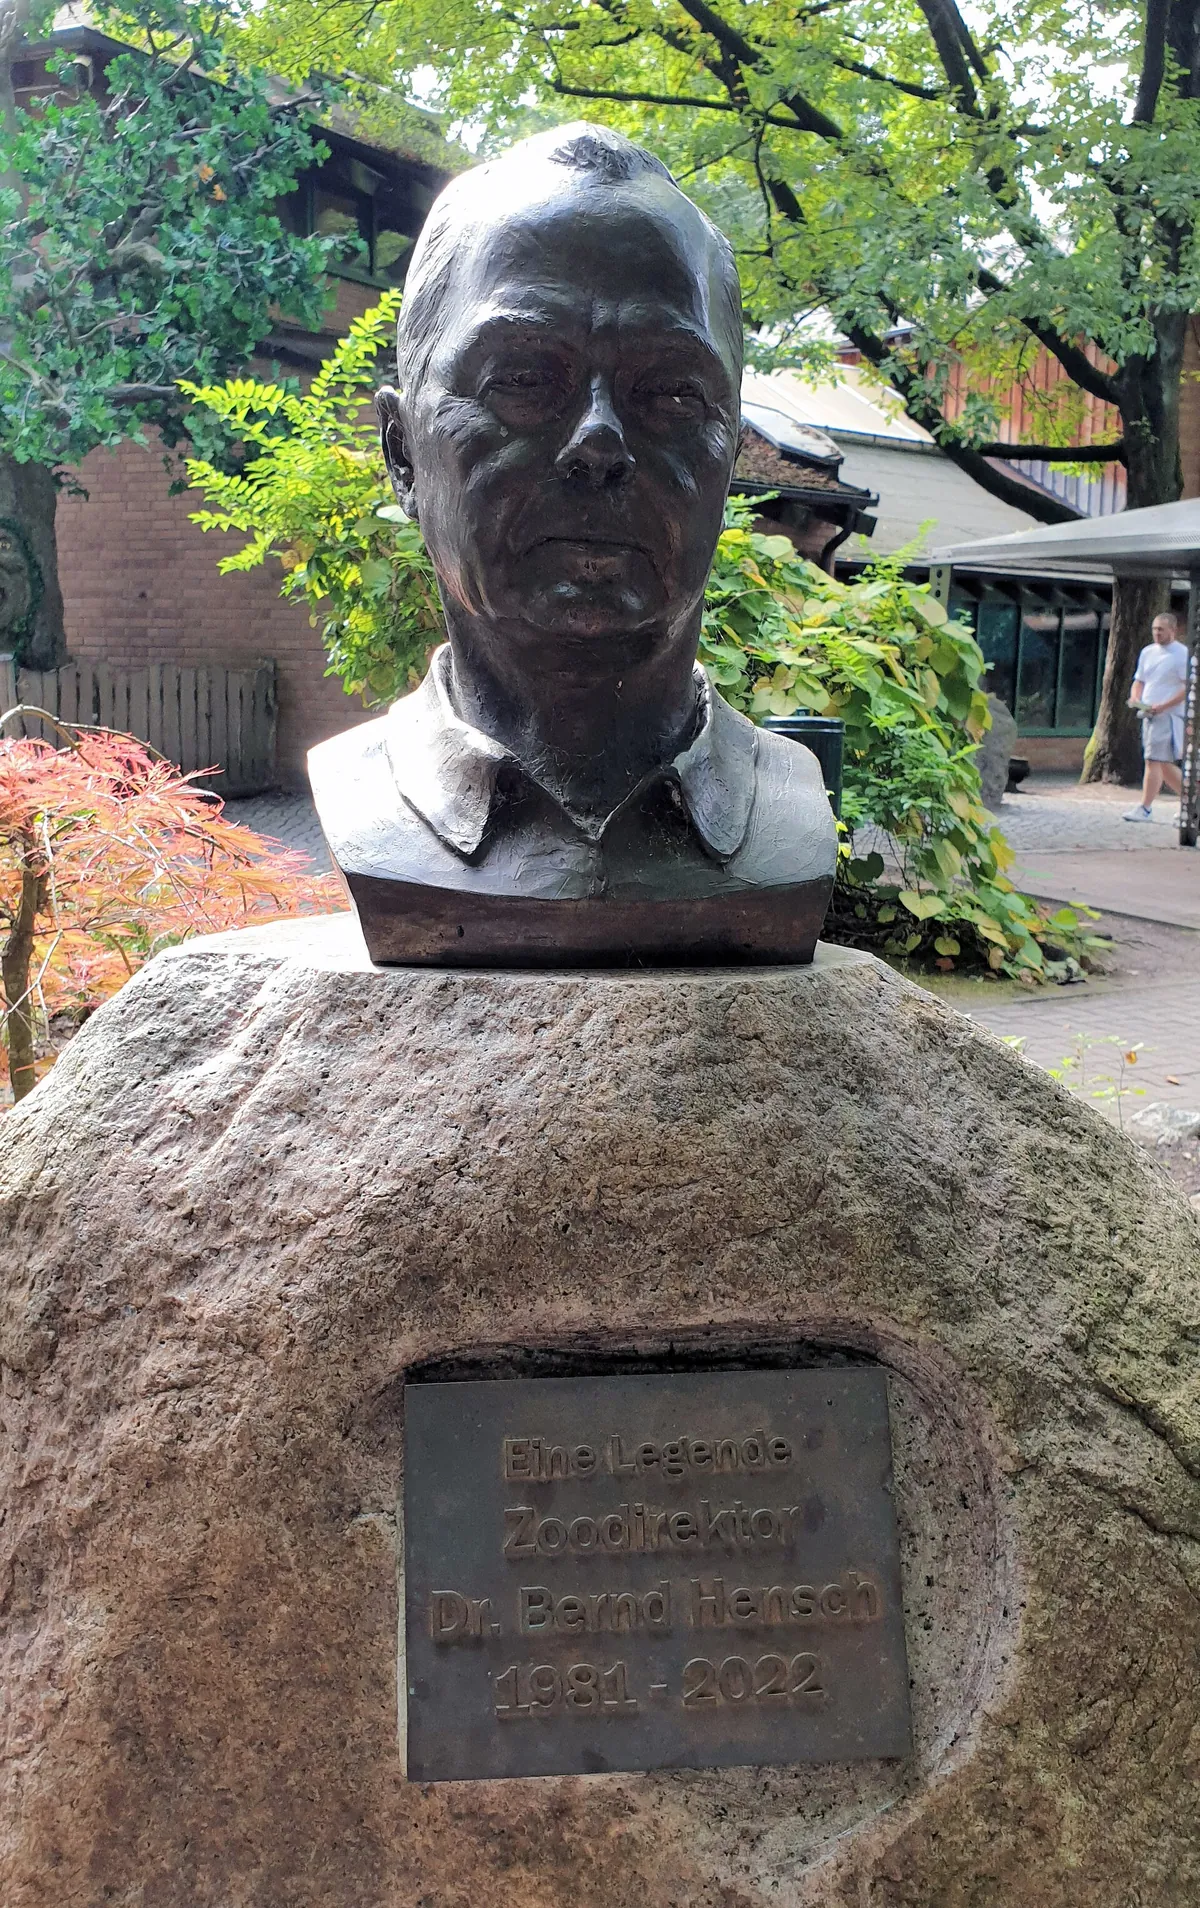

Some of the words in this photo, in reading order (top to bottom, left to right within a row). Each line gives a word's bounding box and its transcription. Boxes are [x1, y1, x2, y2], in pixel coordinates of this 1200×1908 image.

[504, 1437, 596, 1478] Eine
[610, 1428, 794, 1477] Legende
[504, 1501, 800, 1554] Zoodirektor
[430, 1589, 500, 1638] Dr.
[519, 1580, 672, 1632] Bernd
[690, 1571, 879, 1626] Hensch
[495, 1661, 637, 1712] 1981
[682, 1652, 825, 1704] 2022
